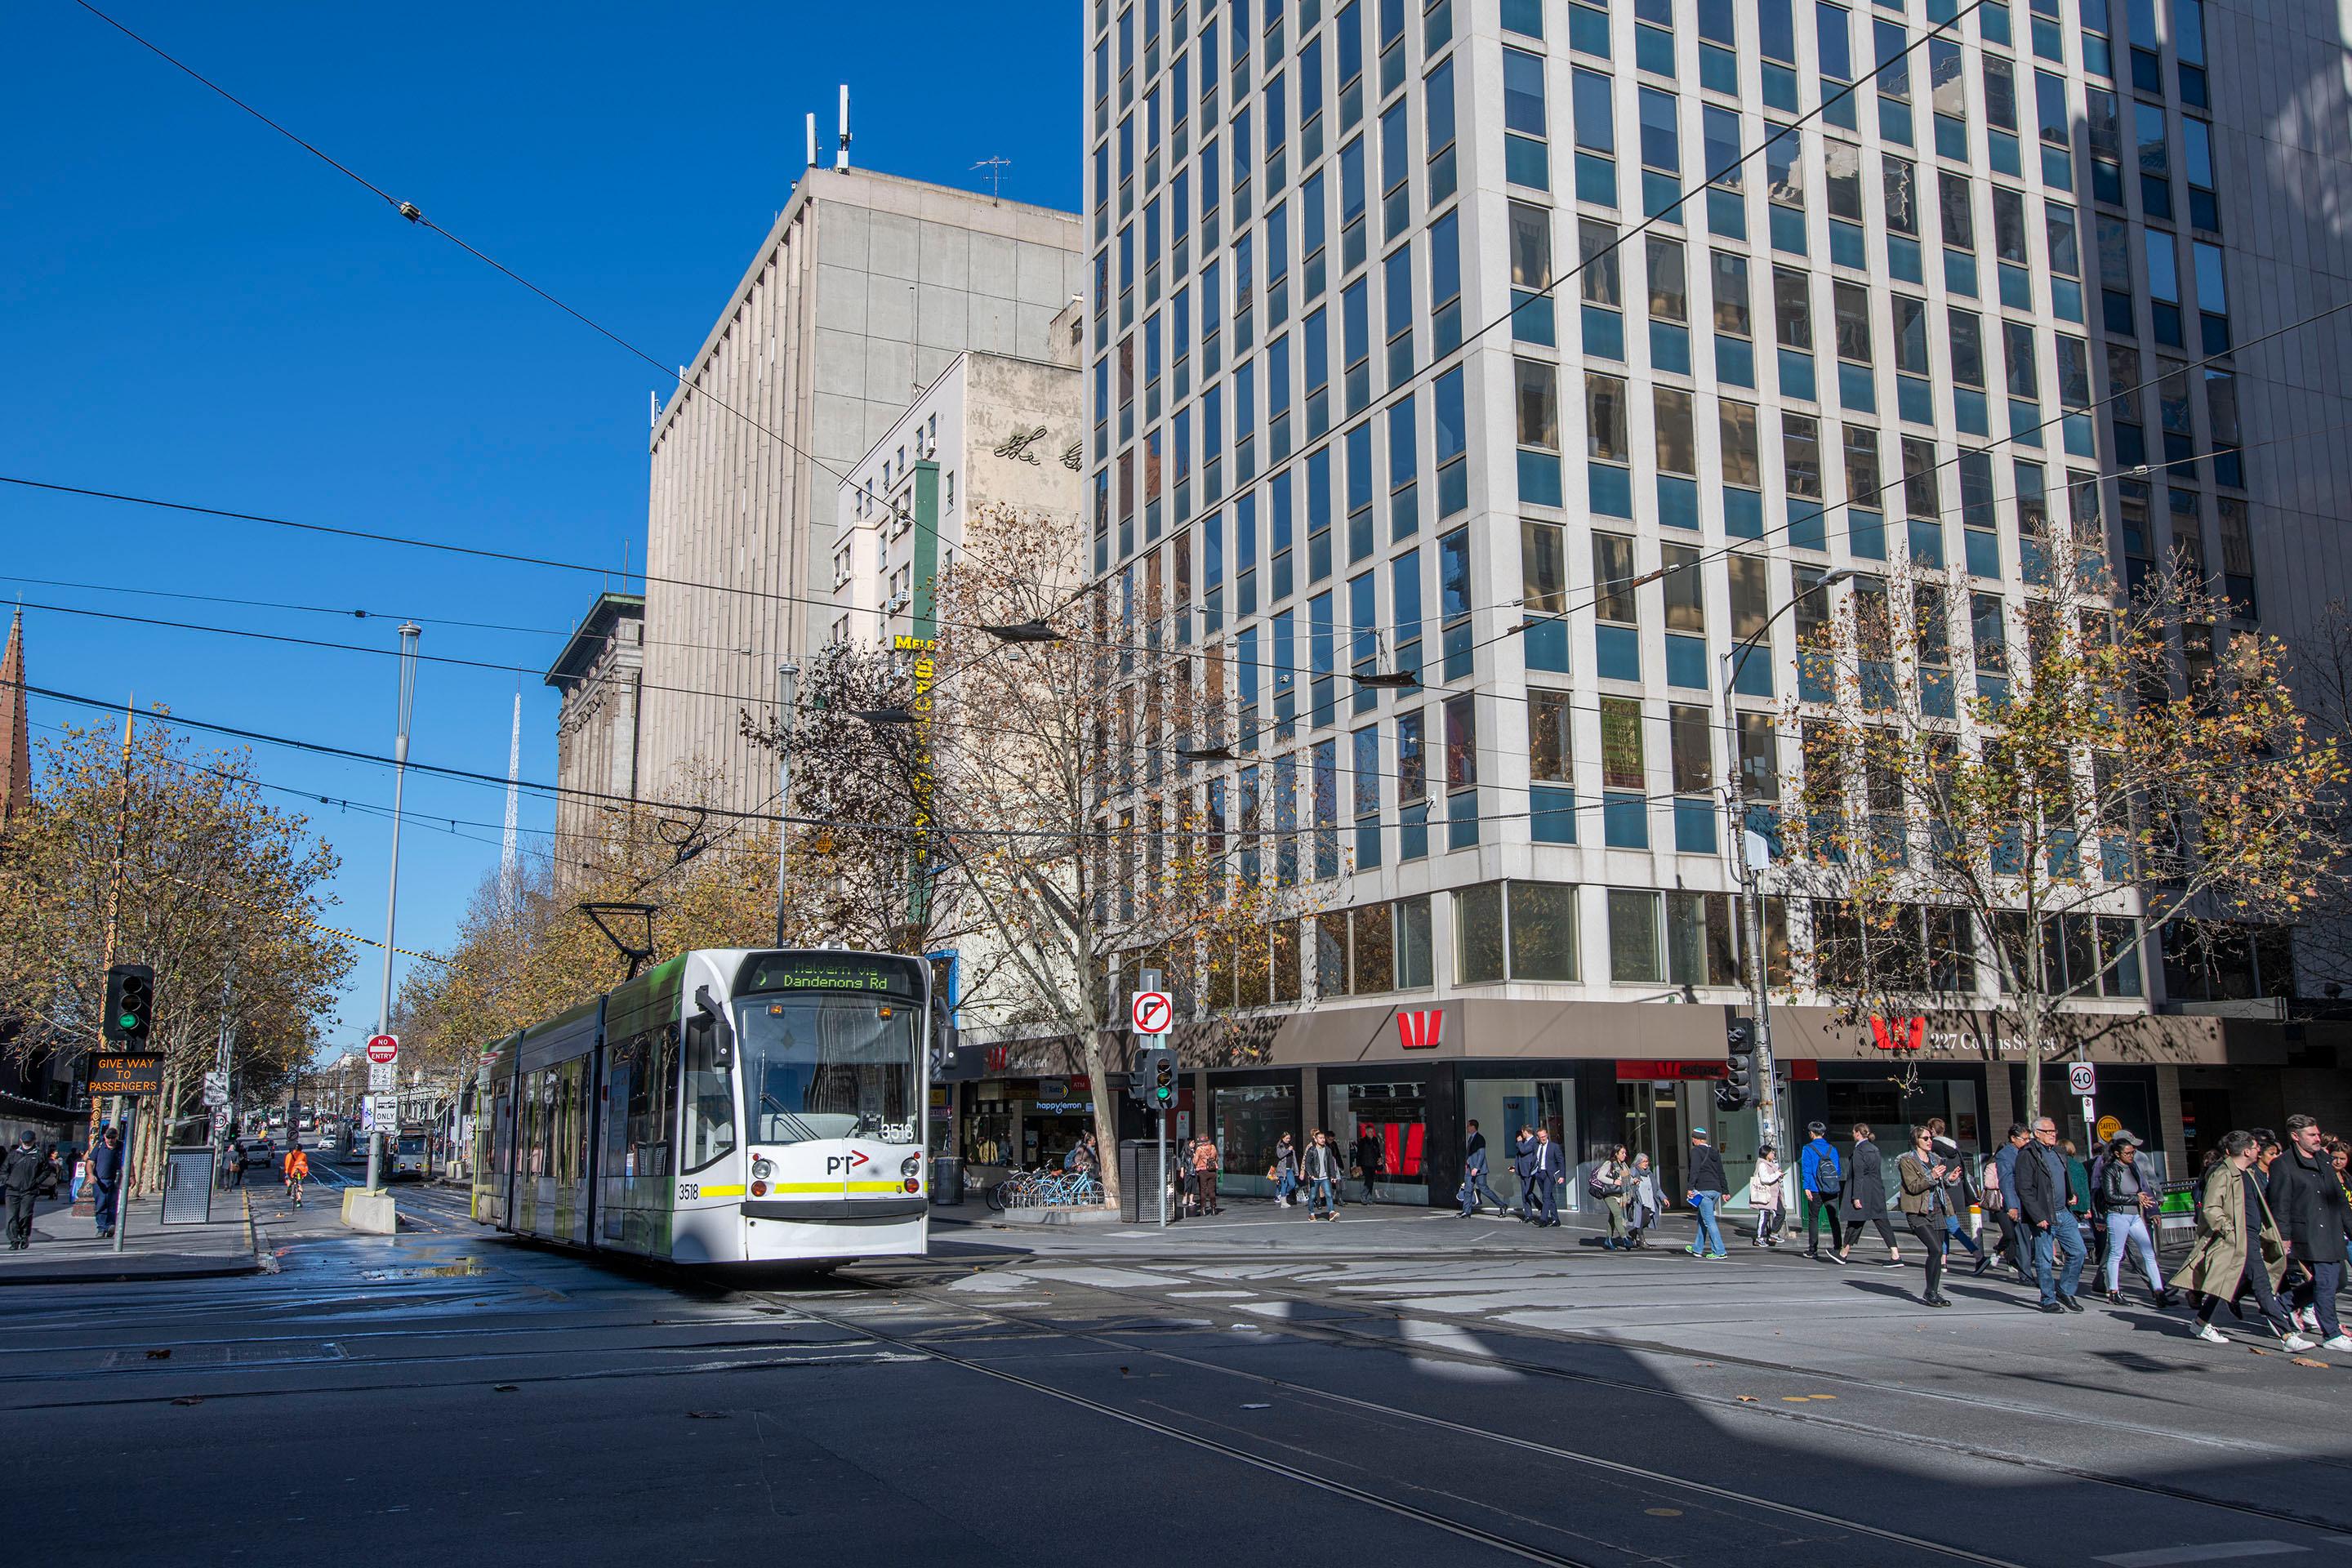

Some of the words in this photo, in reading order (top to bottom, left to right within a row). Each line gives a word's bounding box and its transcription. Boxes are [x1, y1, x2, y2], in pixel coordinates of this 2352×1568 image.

[795, 962, 850, 975] Malvern
[858, 964, 878, 976] via
[784, 974, 863, 989] Dandenong
[870, 978, 888, 990] Rd
[1931, 1033, 1958, 1049] 227
[99, 1058, 123, 1069] GIVE
[127, 1058, 154, 1069] WAY
[116, 1070, 131, 1079] TO
[2073, 1071, 2091, 1085] 40
[89, 1081, 157, 1092] PASSENGERS
[881, 1124, 913, 1139] 3518
[679, 1183, 698, 1200] 3518
